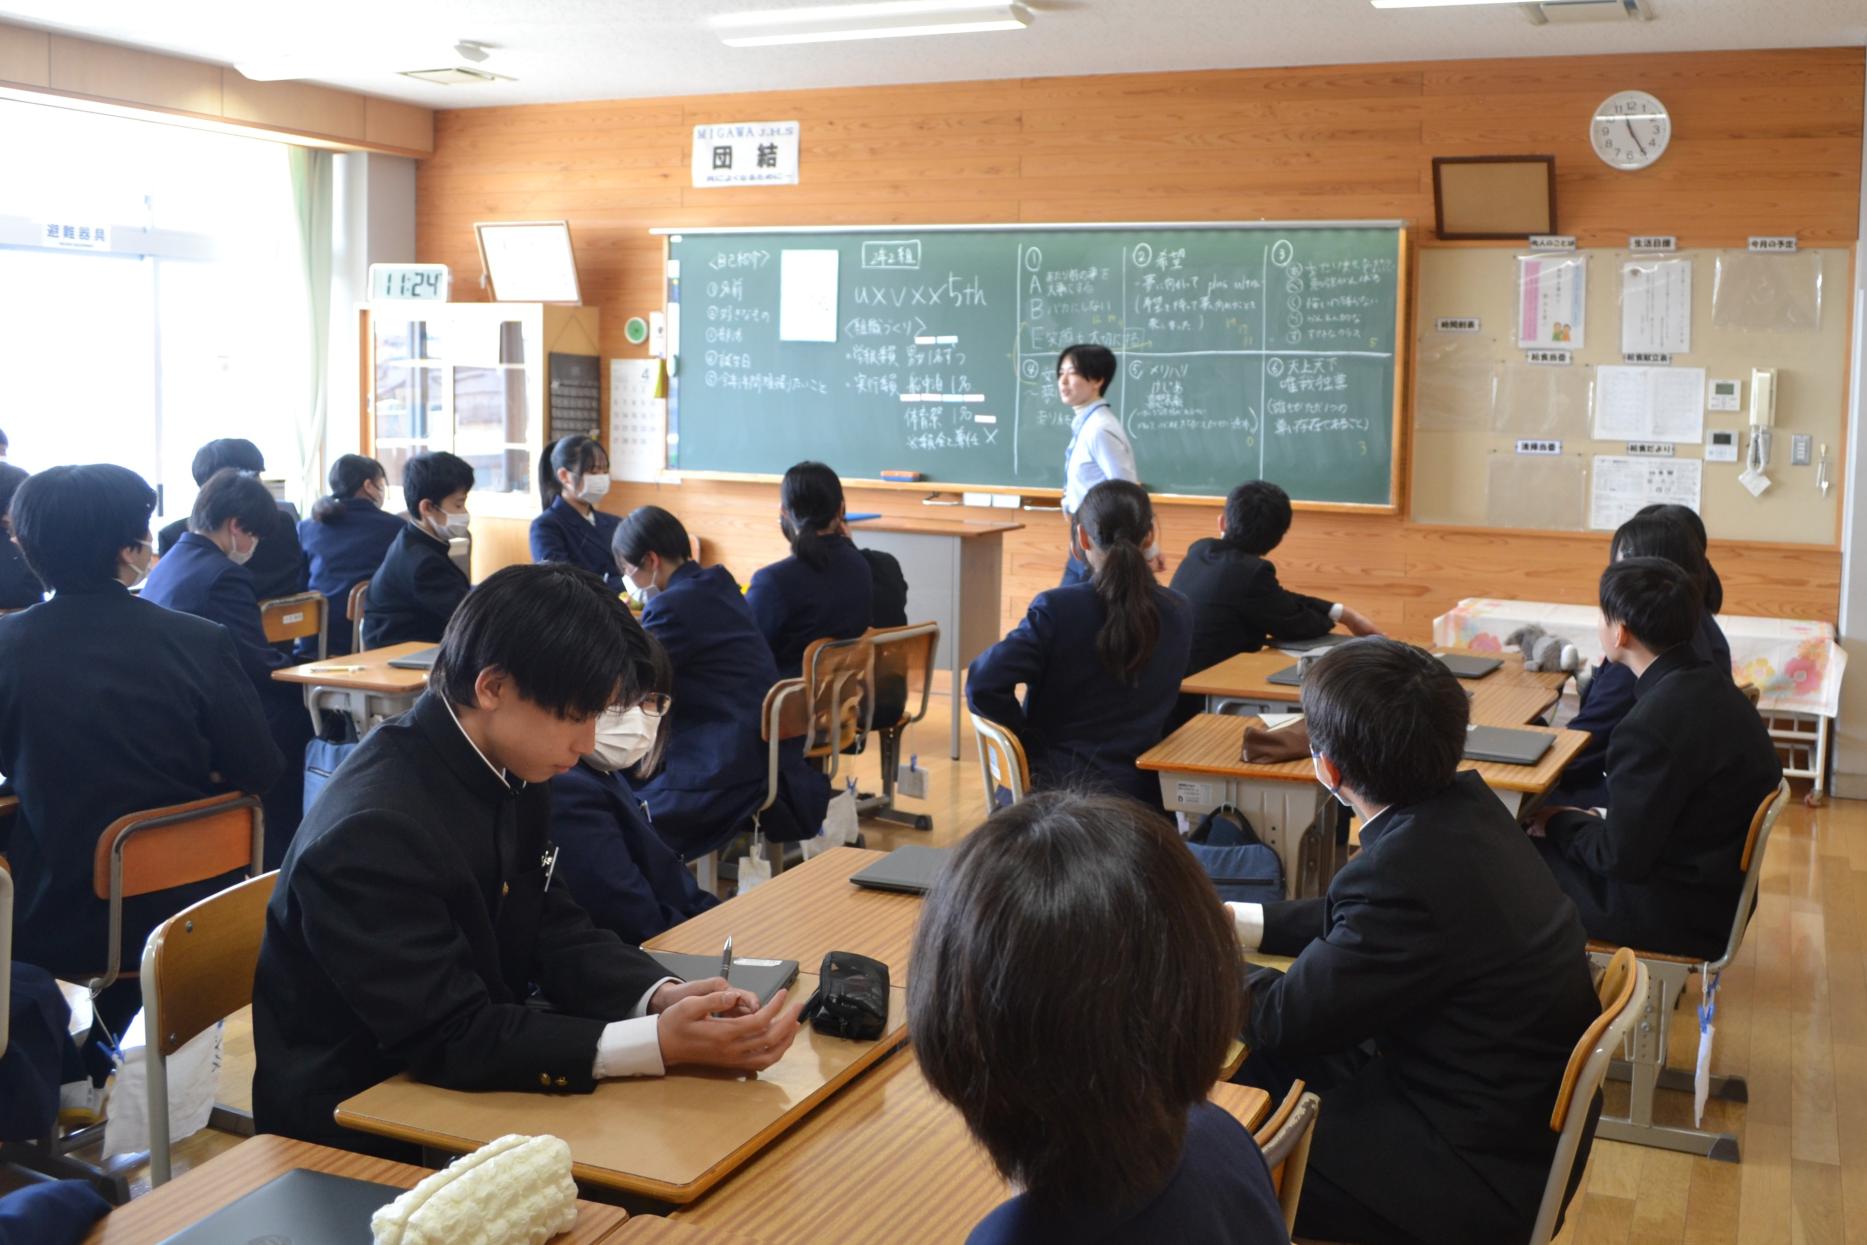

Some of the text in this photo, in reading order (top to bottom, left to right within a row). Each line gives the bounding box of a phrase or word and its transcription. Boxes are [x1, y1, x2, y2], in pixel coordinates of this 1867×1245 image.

[1614, 105, 1623, 114] 11
[1626, 101, 1637, 111] 12
[1602, 126, 1610, 136] 9
[1652, 125, 1661, 135] 3
[1605, 139, 1614, 149] 8
[1648, 138, 1657, 147] 4
[1614, 147, 1621, 157] 7
[1626, 151, 1634, 161] 6
[386, 271, 440, 297] 11:24
[1029, 274, 1043, 295] A
